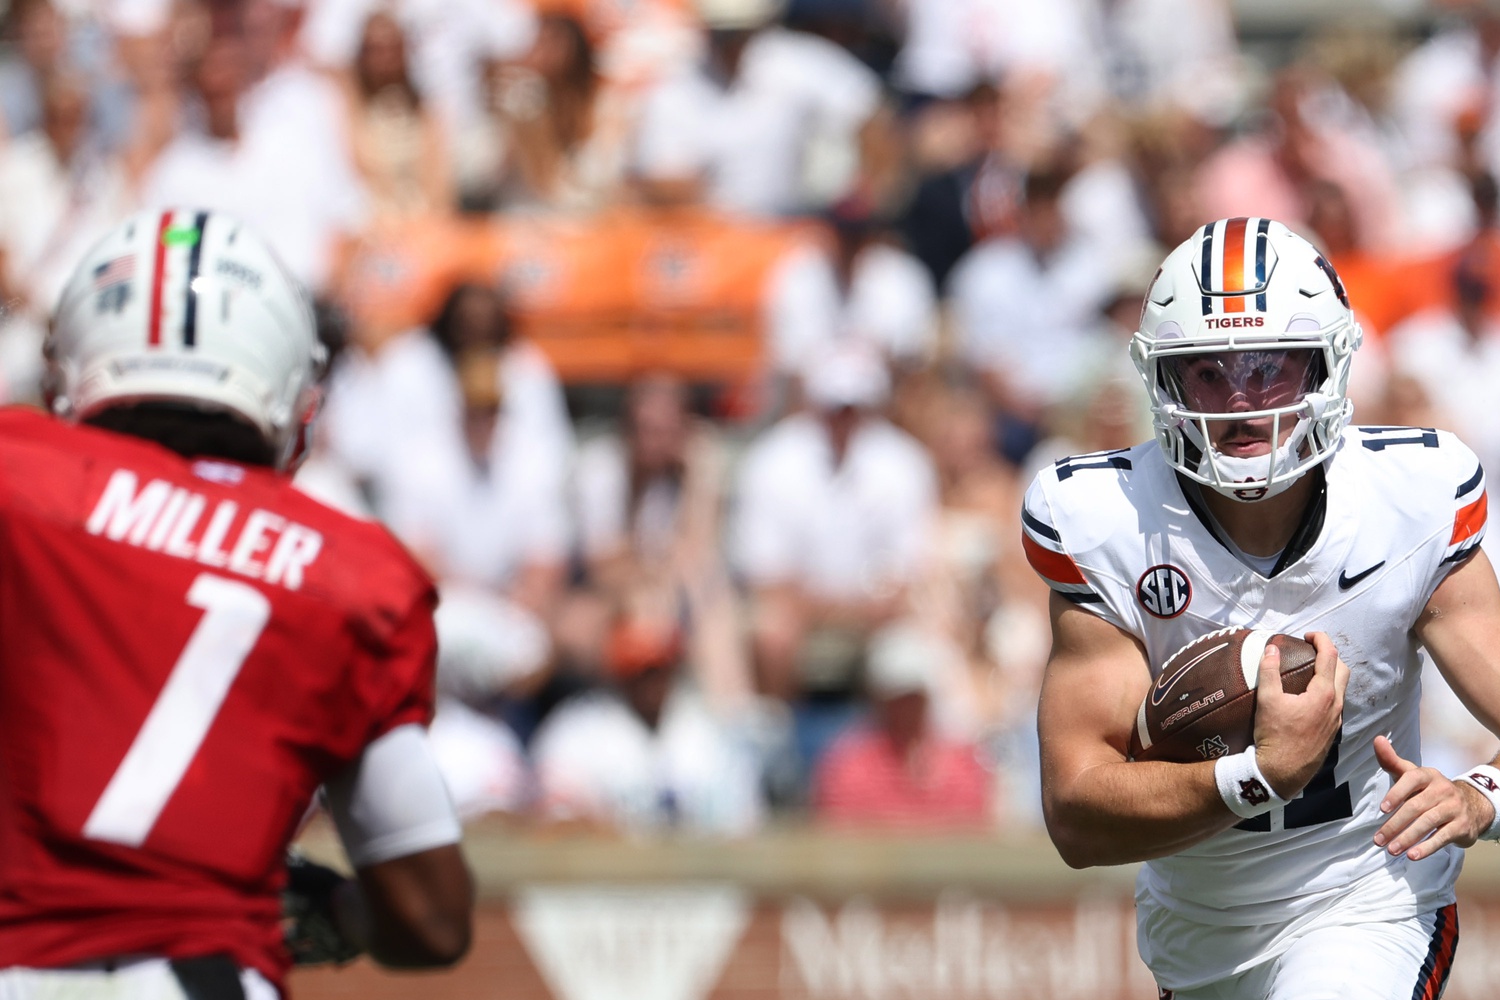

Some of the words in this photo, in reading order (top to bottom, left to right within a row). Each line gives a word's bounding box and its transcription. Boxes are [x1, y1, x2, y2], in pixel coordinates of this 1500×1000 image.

[1205, 317, 1265, 330] TIGERS
[85, 470, 324, 592] MILLER
[1141, 568, 1188, 616] SEC
[82, 574, 273, 848] 1
[1189, 689, 1225, 715] ELITE
